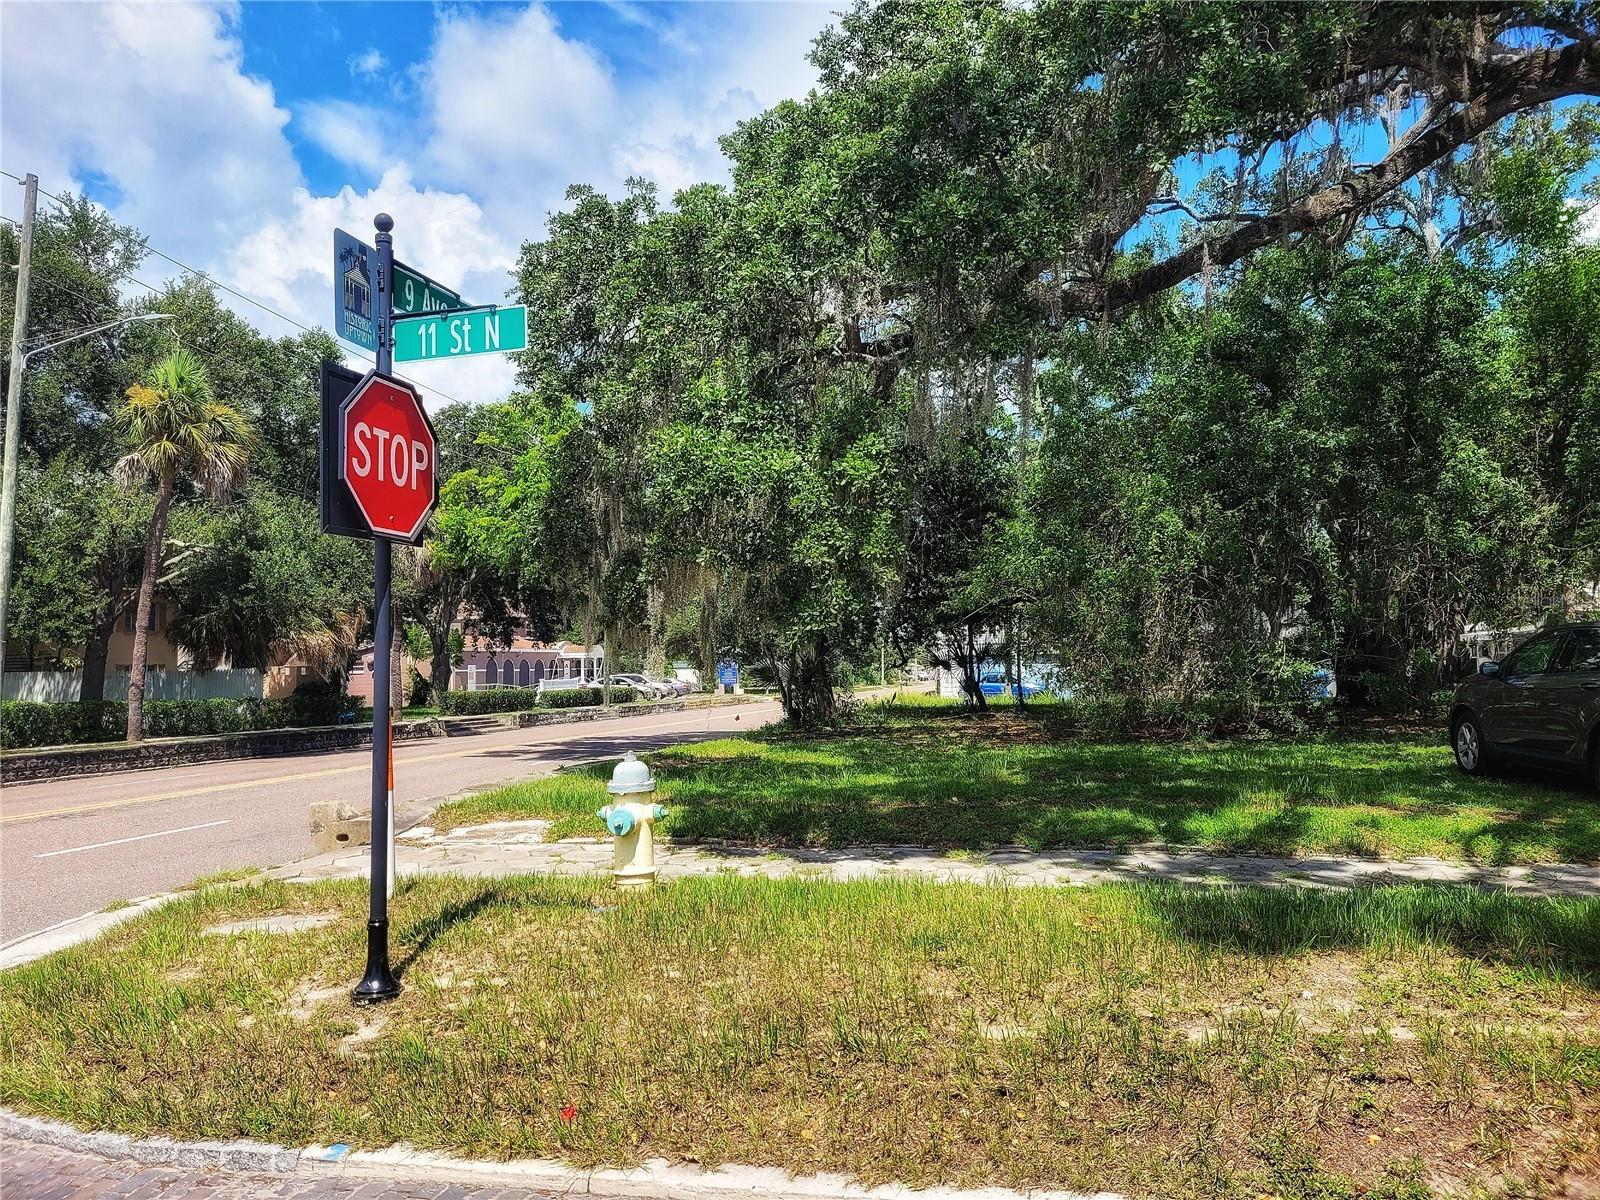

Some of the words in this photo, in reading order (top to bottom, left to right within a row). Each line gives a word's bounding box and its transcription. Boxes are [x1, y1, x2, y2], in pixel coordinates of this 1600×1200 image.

[405, 279, 414, 312] 9
[344, 310, 372, 334] HISTORIC
[344, 323, 373, 346] UPTOWN
[418, 322, 437, 357] 11
[450, 319, 472, 354] St
[485, 315, 500, 350] N
[351, 422, 429, 491] STOP
